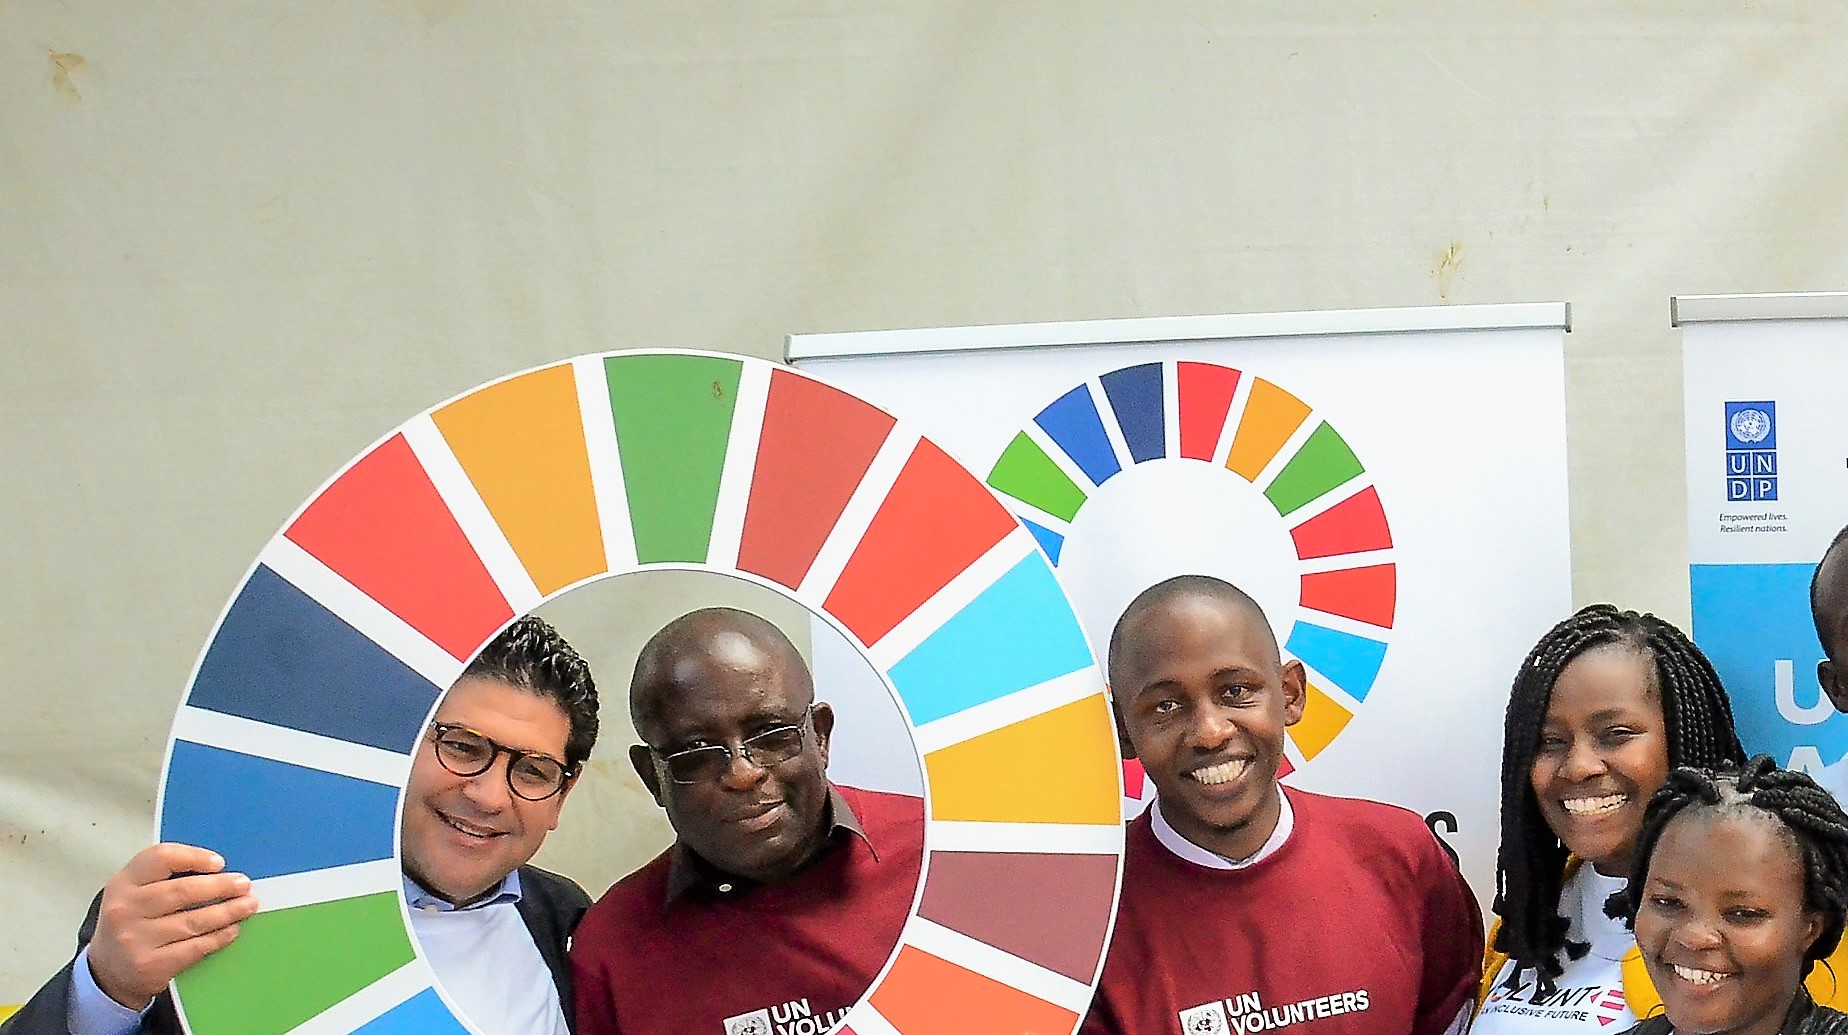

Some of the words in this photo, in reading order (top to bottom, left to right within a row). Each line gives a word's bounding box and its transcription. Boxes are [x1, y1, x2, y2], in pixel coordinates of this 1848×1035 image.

[771, 998, 811, 1024] UN
[1225, 991, 1261, 1017] UN
[1231, 990, 1370, 1035] VOLUNTEERS
[1544, 1009, 1589, 1022] FUTURE
